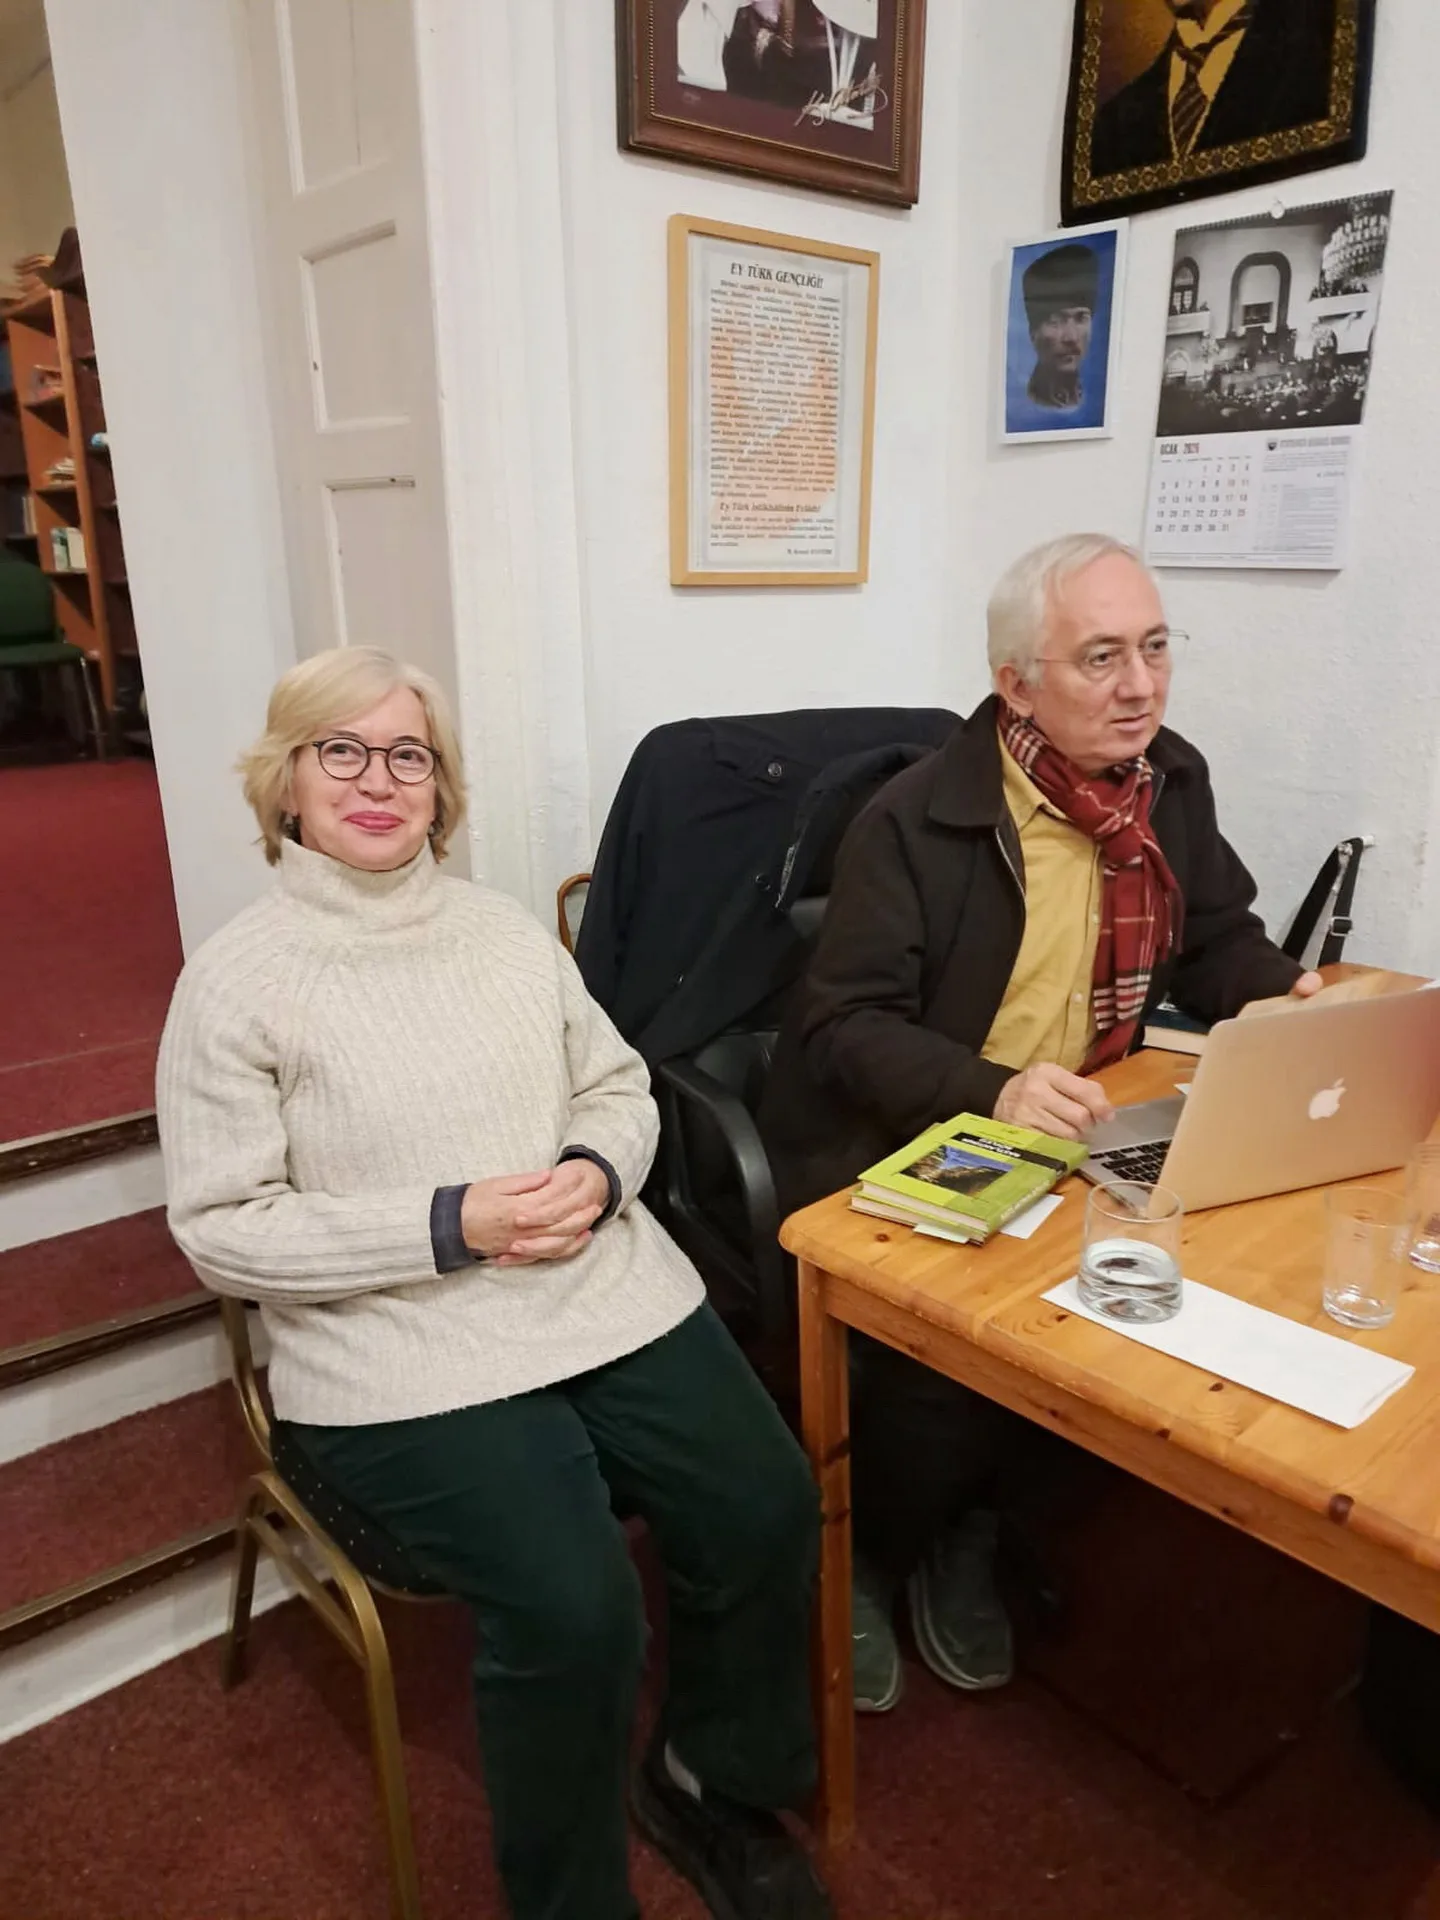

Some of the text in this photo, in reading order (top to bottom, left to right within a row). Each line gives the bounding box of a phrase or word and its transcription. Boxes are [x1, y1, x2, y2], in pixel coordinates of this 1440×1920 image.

[730, 262, 742, 276] EY
[748, 263, 772, 280] TÜRK
[1160, 443, 1178, 455] OCAK
